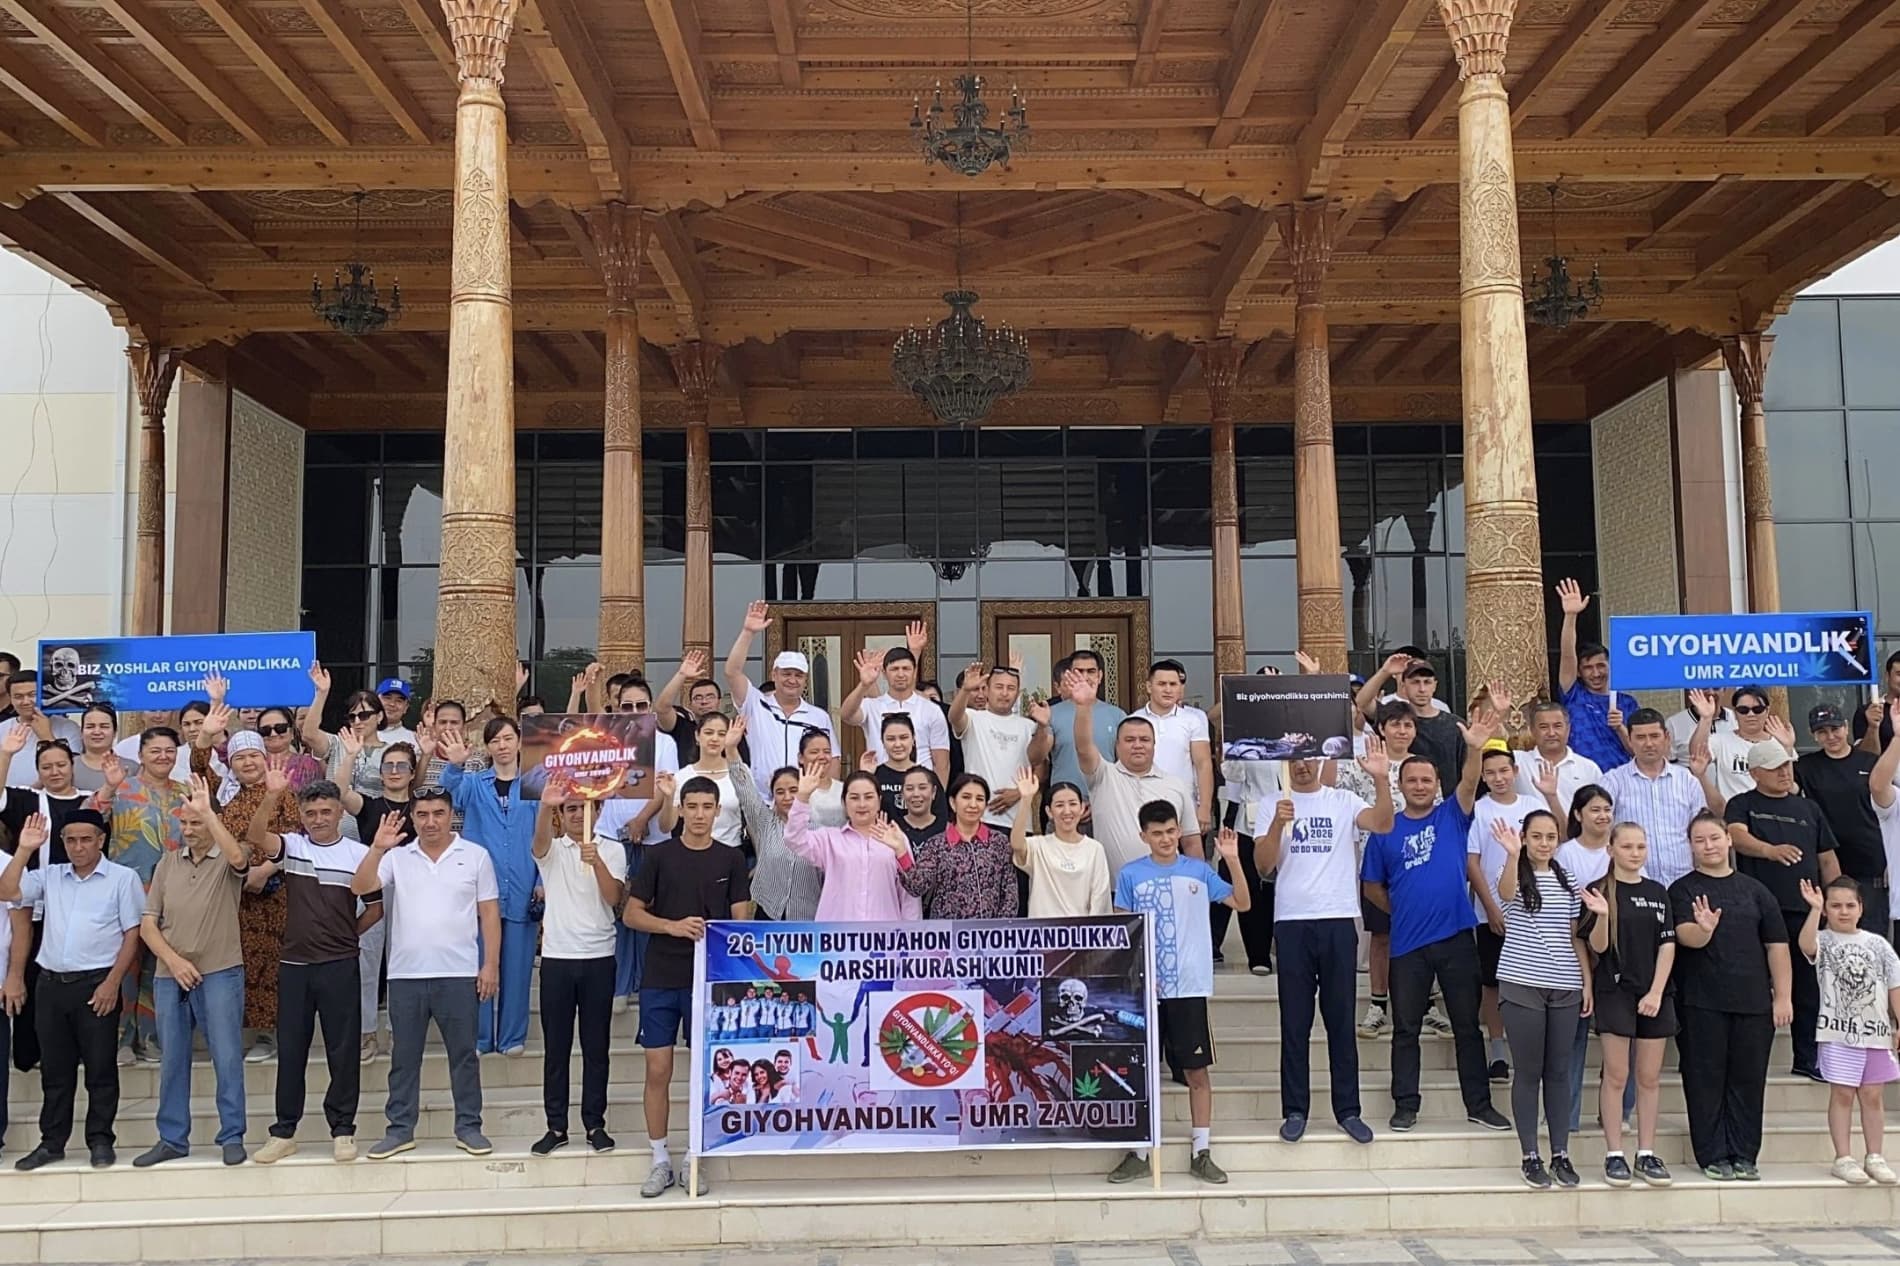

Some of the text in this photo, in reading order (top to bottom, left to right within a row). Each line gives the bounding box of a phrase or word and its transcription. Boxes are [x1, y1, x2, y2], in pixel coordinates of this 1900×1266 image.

[1628, 630, 1854, 657] GIYOHVANDLIK
[77, 657, 301, 676] BIZ YOSHLAR GIYOHVANDLIKKA
[1684, 663, 1800, 680] UMR ZAVOLI!
[1236, 693, 1248, 701] Biz
[545, 747, 636, 768] GIYOHVANDLIK
[1311, 829, 1333, 839] 2026
[727, 926, 1130, 955] 26-IYUN BUTUNJAHON GIYOHVANDLIKKA
[820, 955, 1045, 982] QARSHI KURASH KUNI!
[892, 1009, 942, 1060] GIYOHVANDLIKKA
[721, 1105, 937, 1134] GIYOHVANDLIK
[969, 1103, 1030, 1128] UMR
[1037, 1102, 1136, 1126] ZAVOLI!
